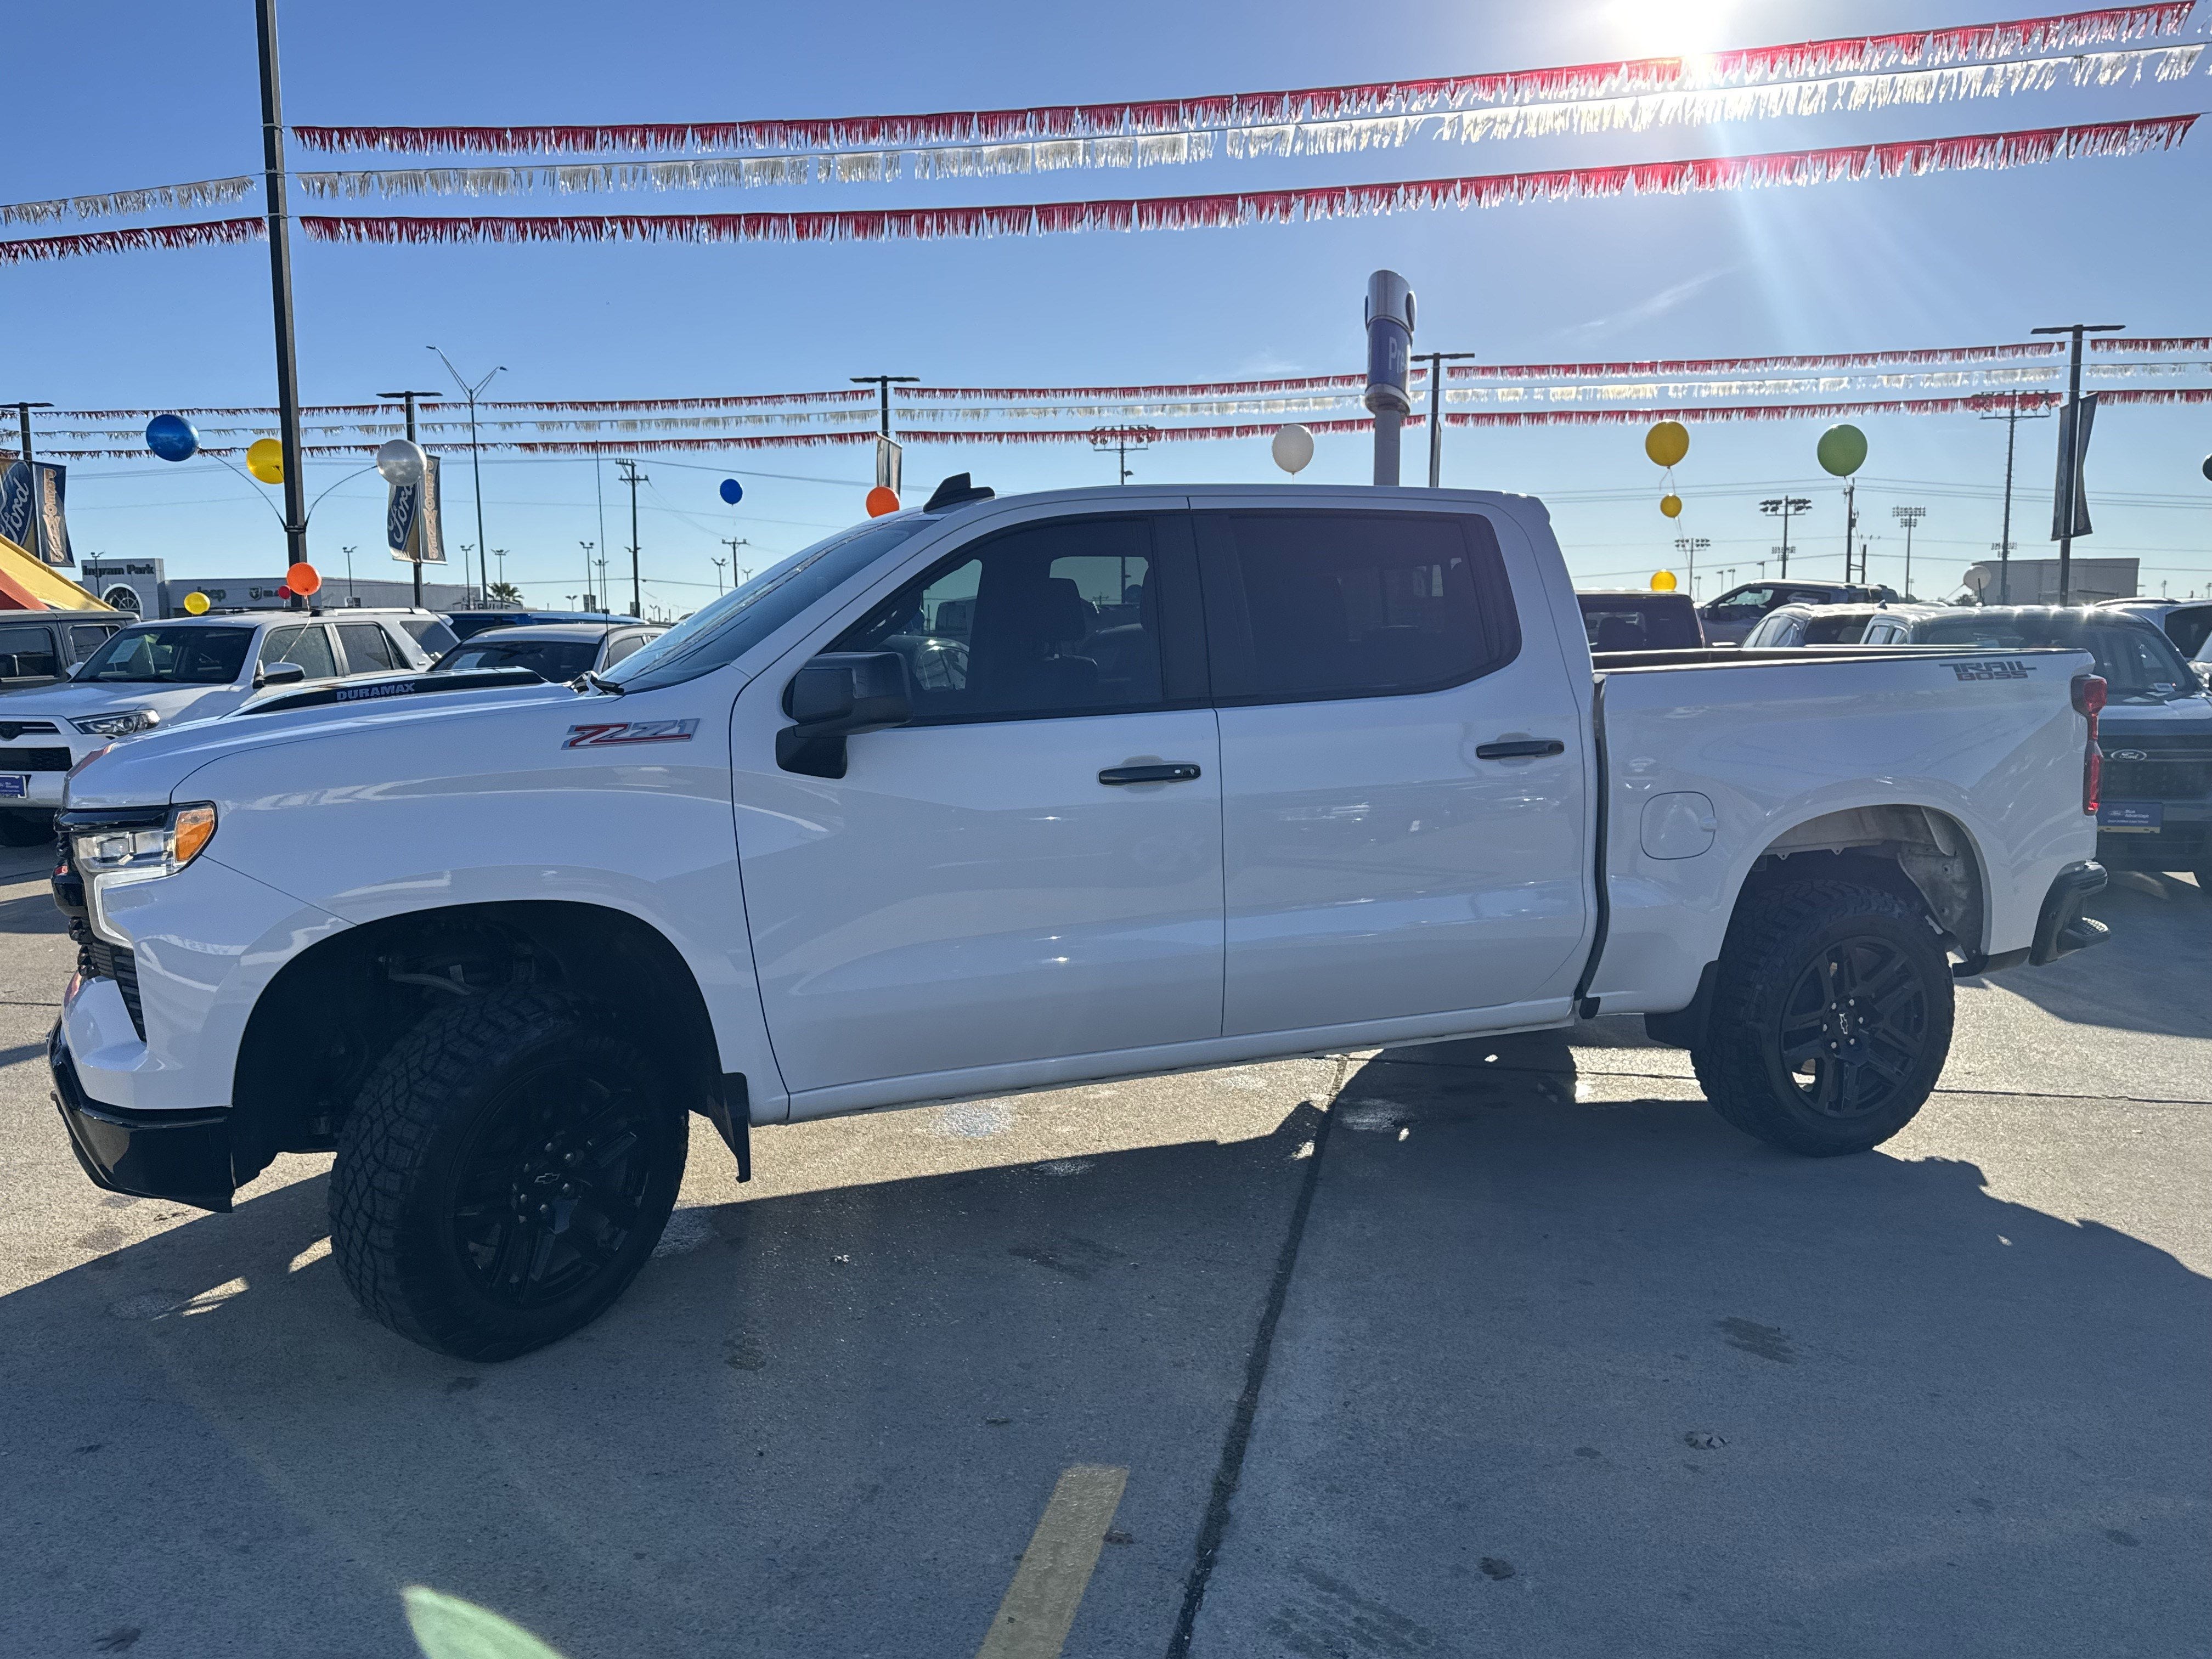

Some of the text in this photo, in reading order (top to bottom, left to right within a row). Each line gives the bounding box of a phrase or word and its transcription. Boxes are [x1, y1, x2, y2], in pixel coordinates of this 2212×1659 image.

[126, 564, 154, 574] Park
[1939, 661, 2037, 673] TRAIL
[1956, 670, 2028, 681] BOSS
[337, 682, 415, 700] DURAMAX
[561, 718, 700, 750] Z71
